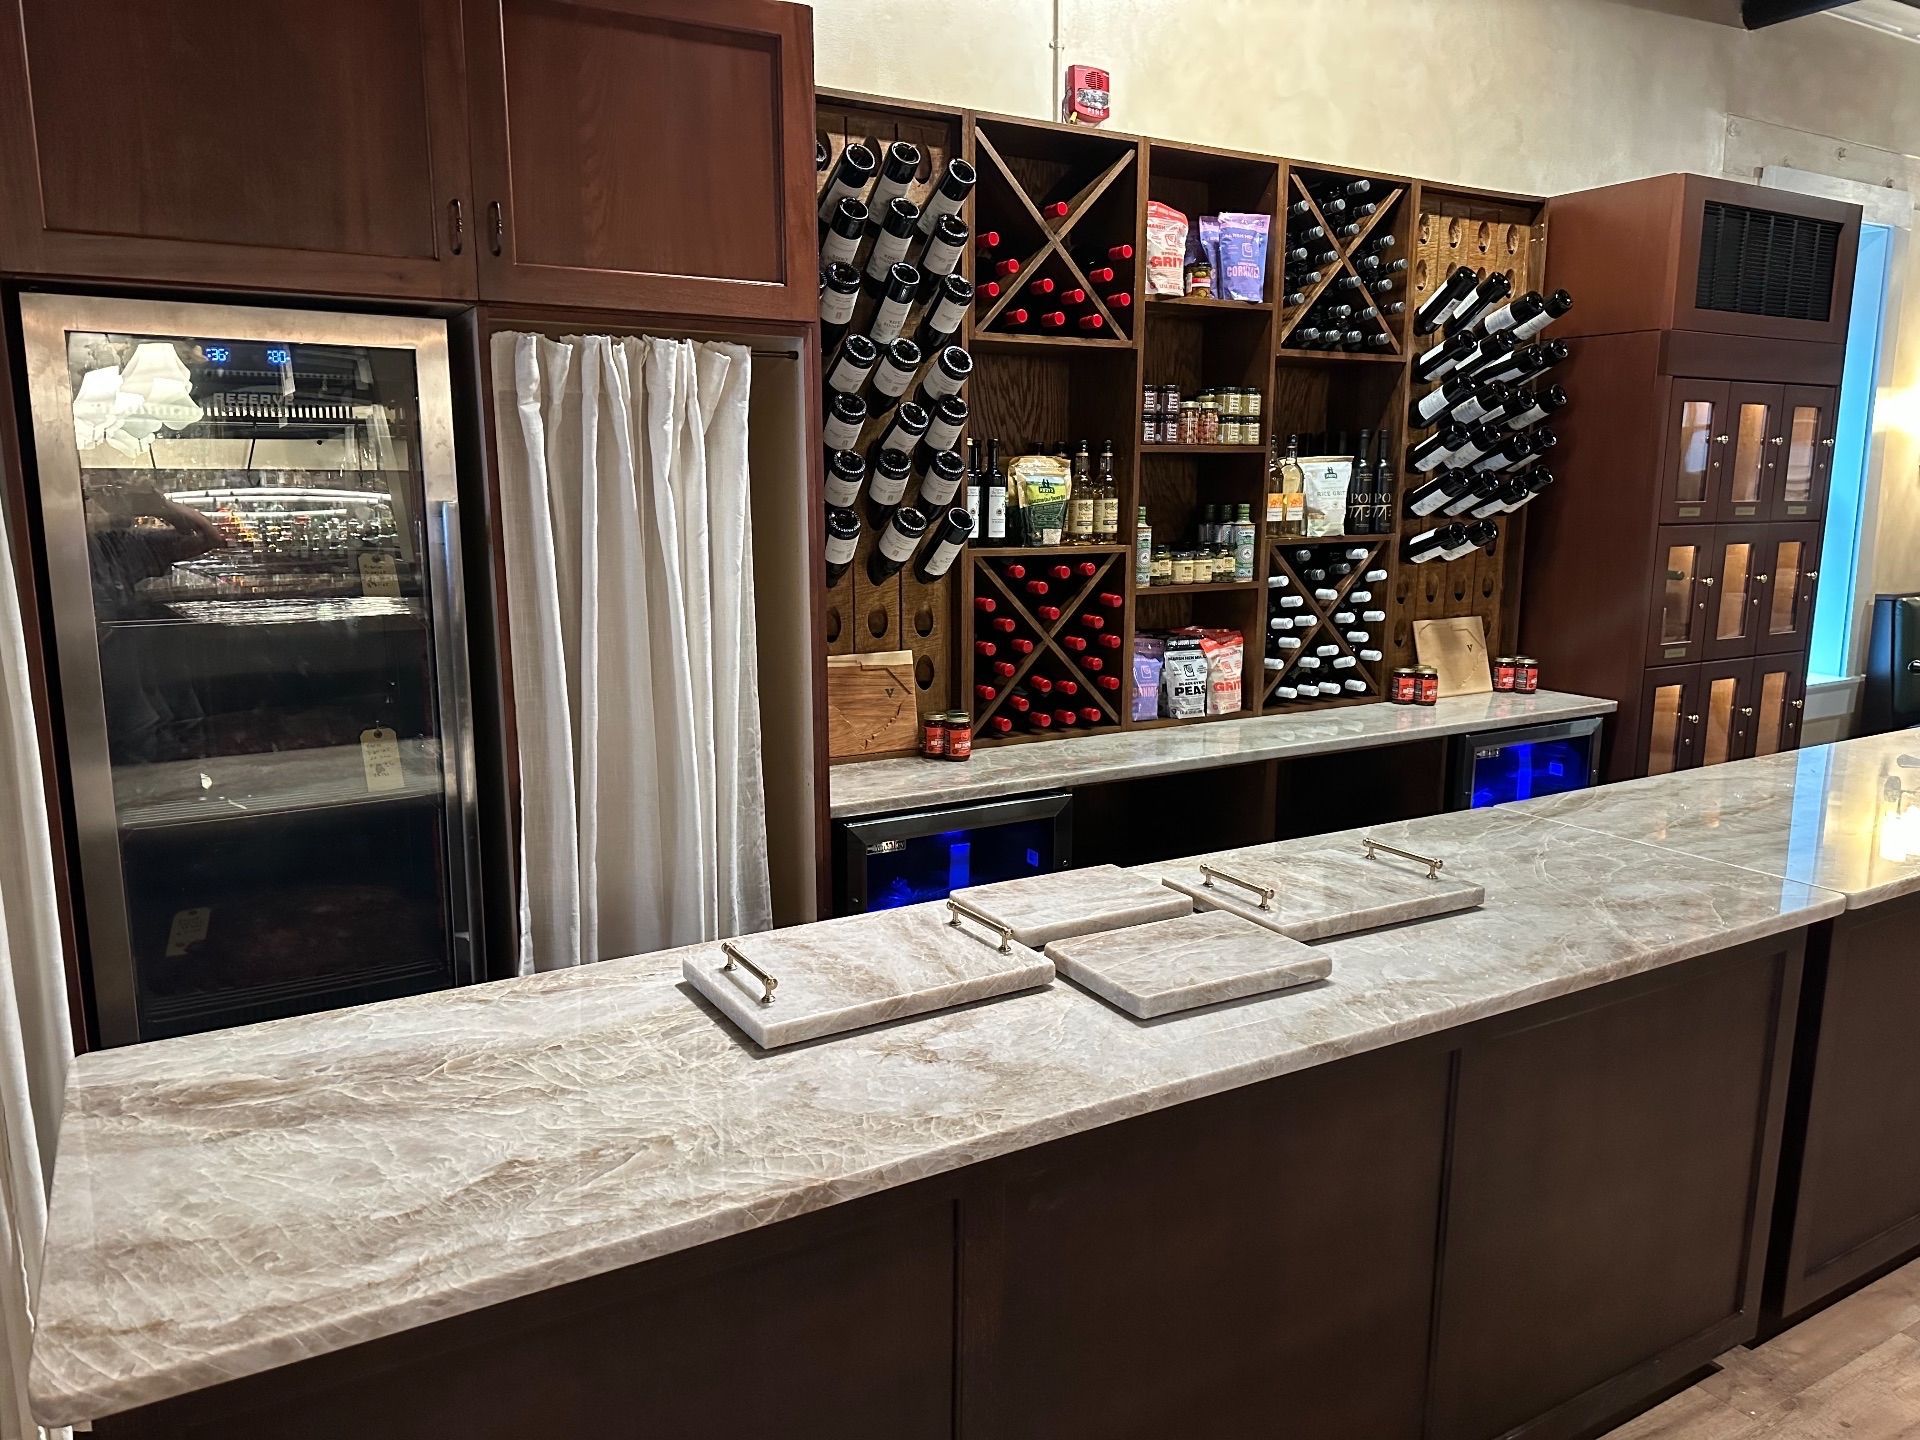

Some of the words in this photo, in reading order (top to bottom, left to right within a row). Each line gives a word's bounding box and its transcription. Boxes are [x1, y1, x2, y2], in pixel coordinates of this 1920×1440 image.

[1087, 107, 1104, 116] FIRE
[213, 392, 294, 406] RESERVE
[1174, 684, 1206, 697] PEAS
